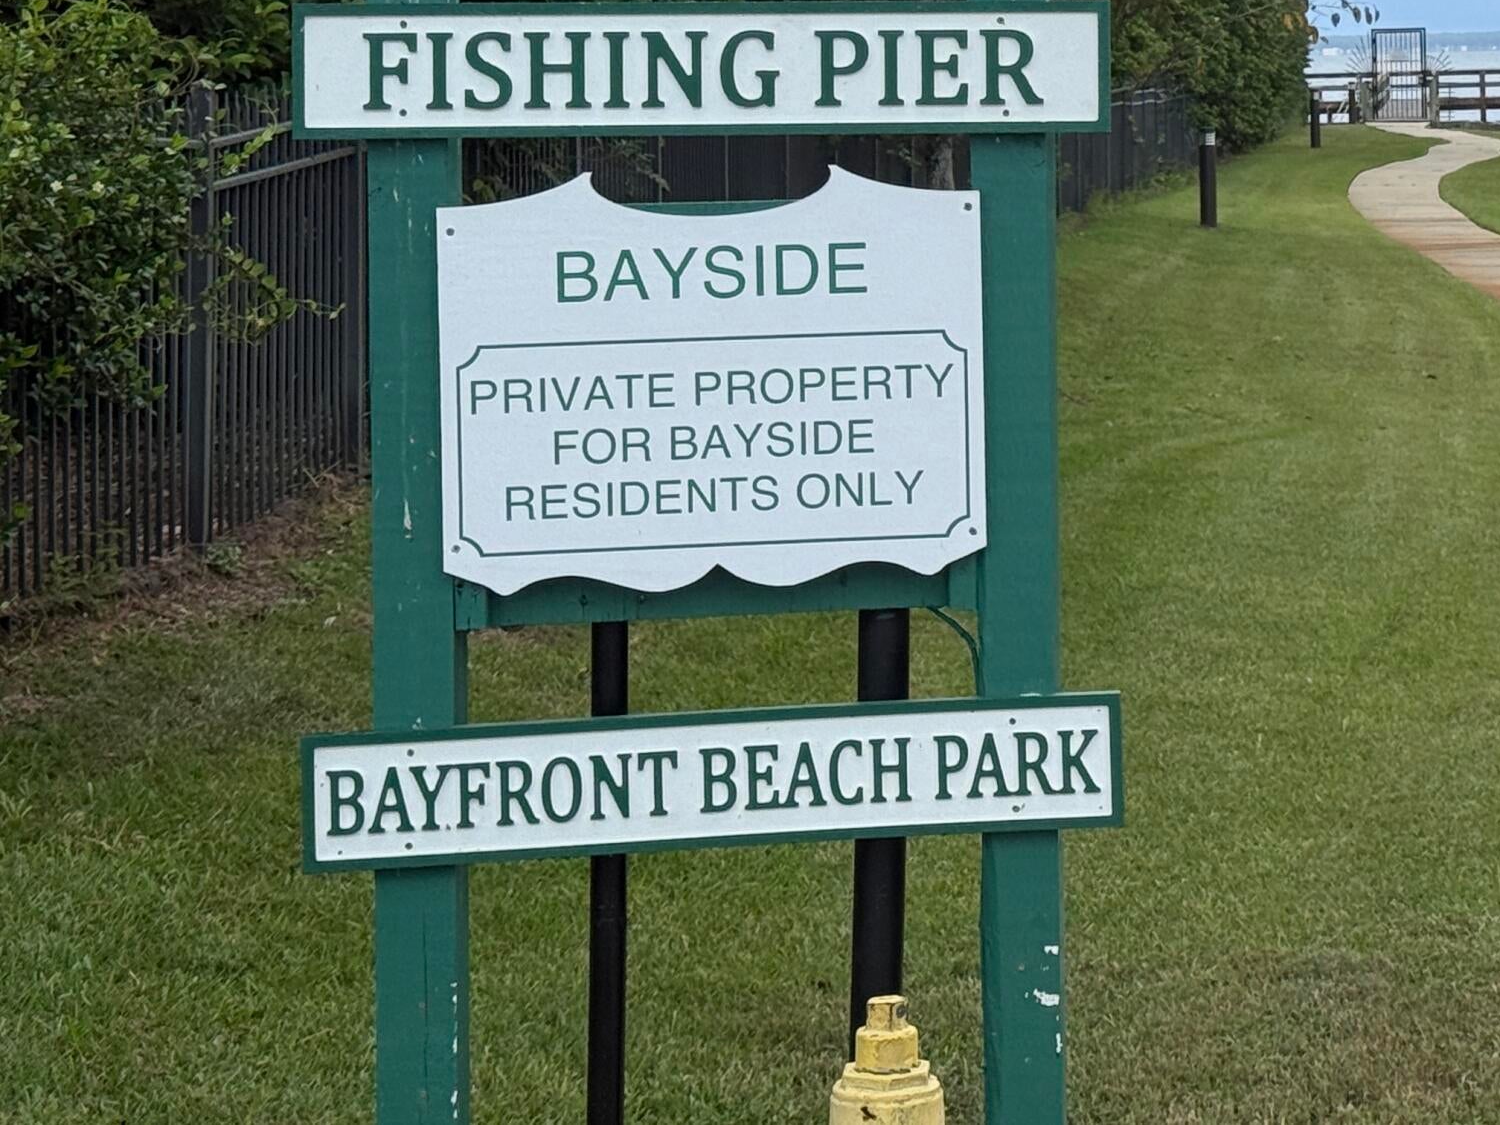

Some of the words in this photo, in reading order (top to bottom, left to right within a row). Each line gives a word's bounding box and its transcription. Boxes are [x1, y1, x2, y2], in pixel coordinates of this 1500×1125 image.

[363, 30, 780, 110] FISHING
[814, 28, 1044, 106] PIER
[556, 242, 867, 303] BAYSIDE
[470, 373, 676, 415] PRIVATE
[695, 363, 953, 406] PROPERTY
[554, 427, 651, 465] FOR
[671, 419, 875, 461] BAYSIDE
[506, 476, 779, 520] RESIDENTS
[796, 470, 924, 509] ONLY
[326, 749, 678, 836] BAYFRONT
[699, 736, 913, 813] BEACH
[934, 728, 1101, 799] PARK
